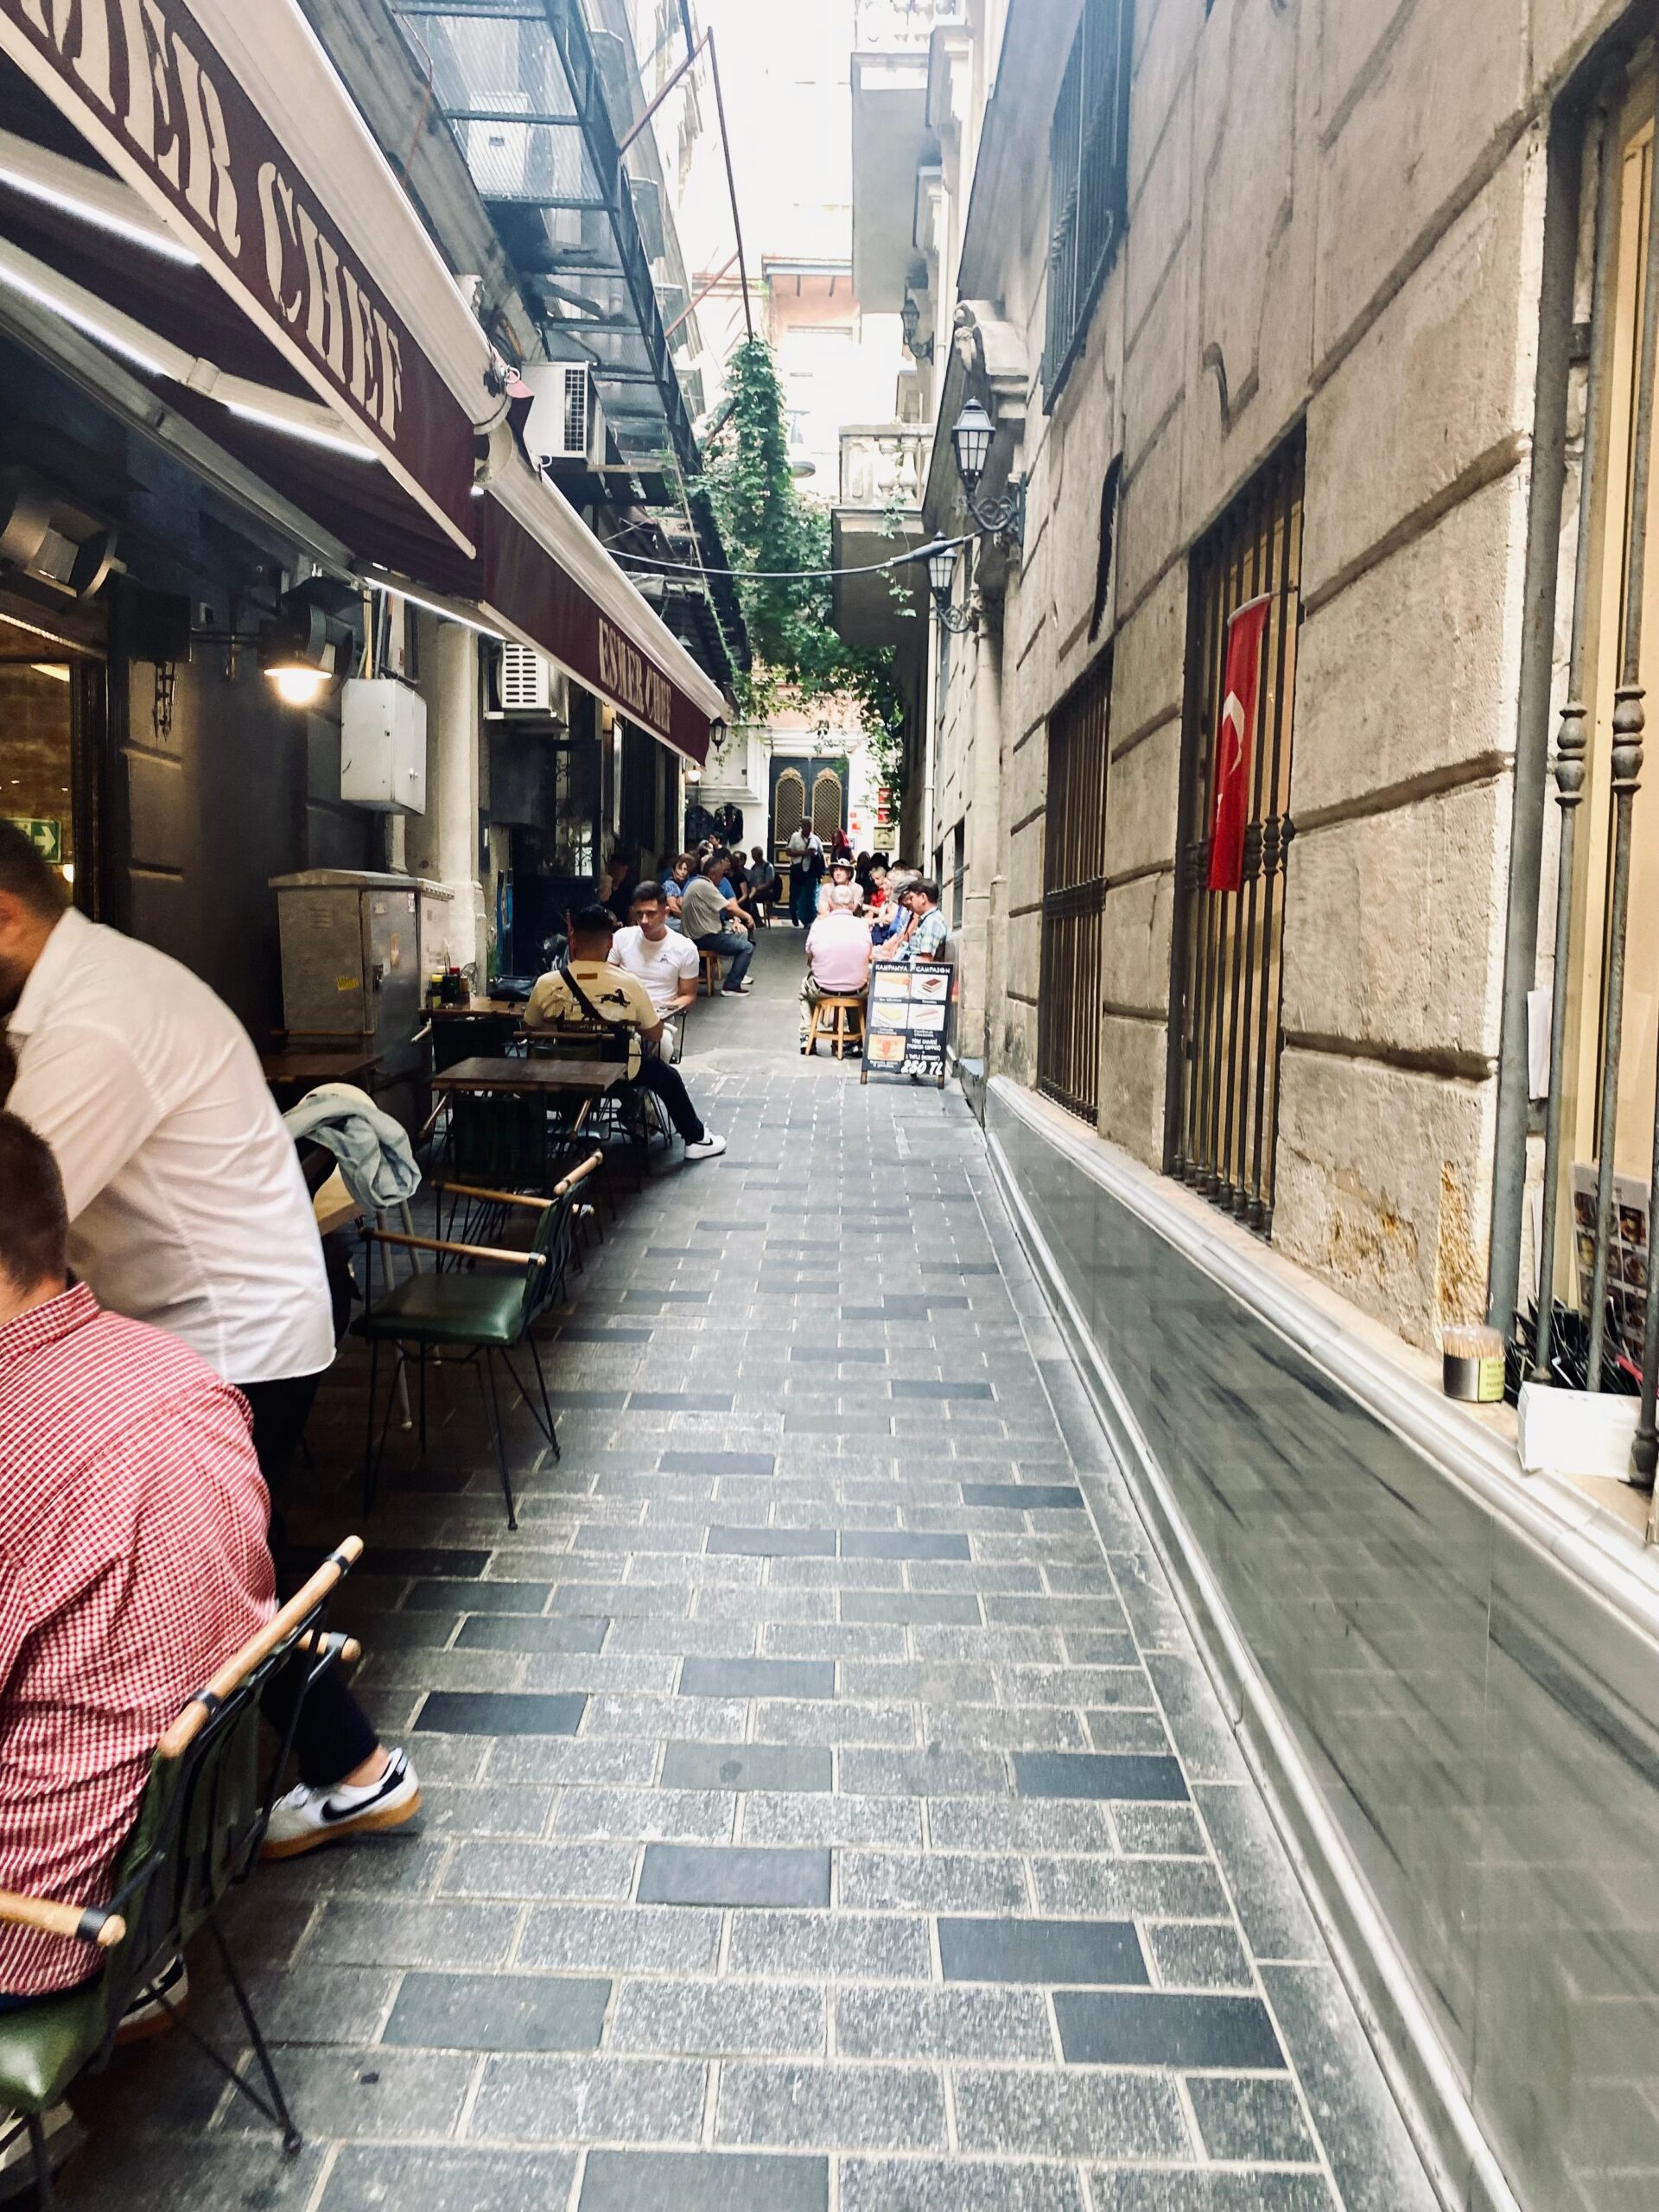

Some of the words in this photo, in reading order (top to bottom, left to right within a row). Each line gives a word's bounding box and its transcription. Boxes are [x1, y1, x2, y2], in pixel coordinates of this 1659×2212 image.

[257, 162, 403, 442] CHEF
[900, 1059, 927, 1075] 250
[929, 1061, 944, 1076] TL
